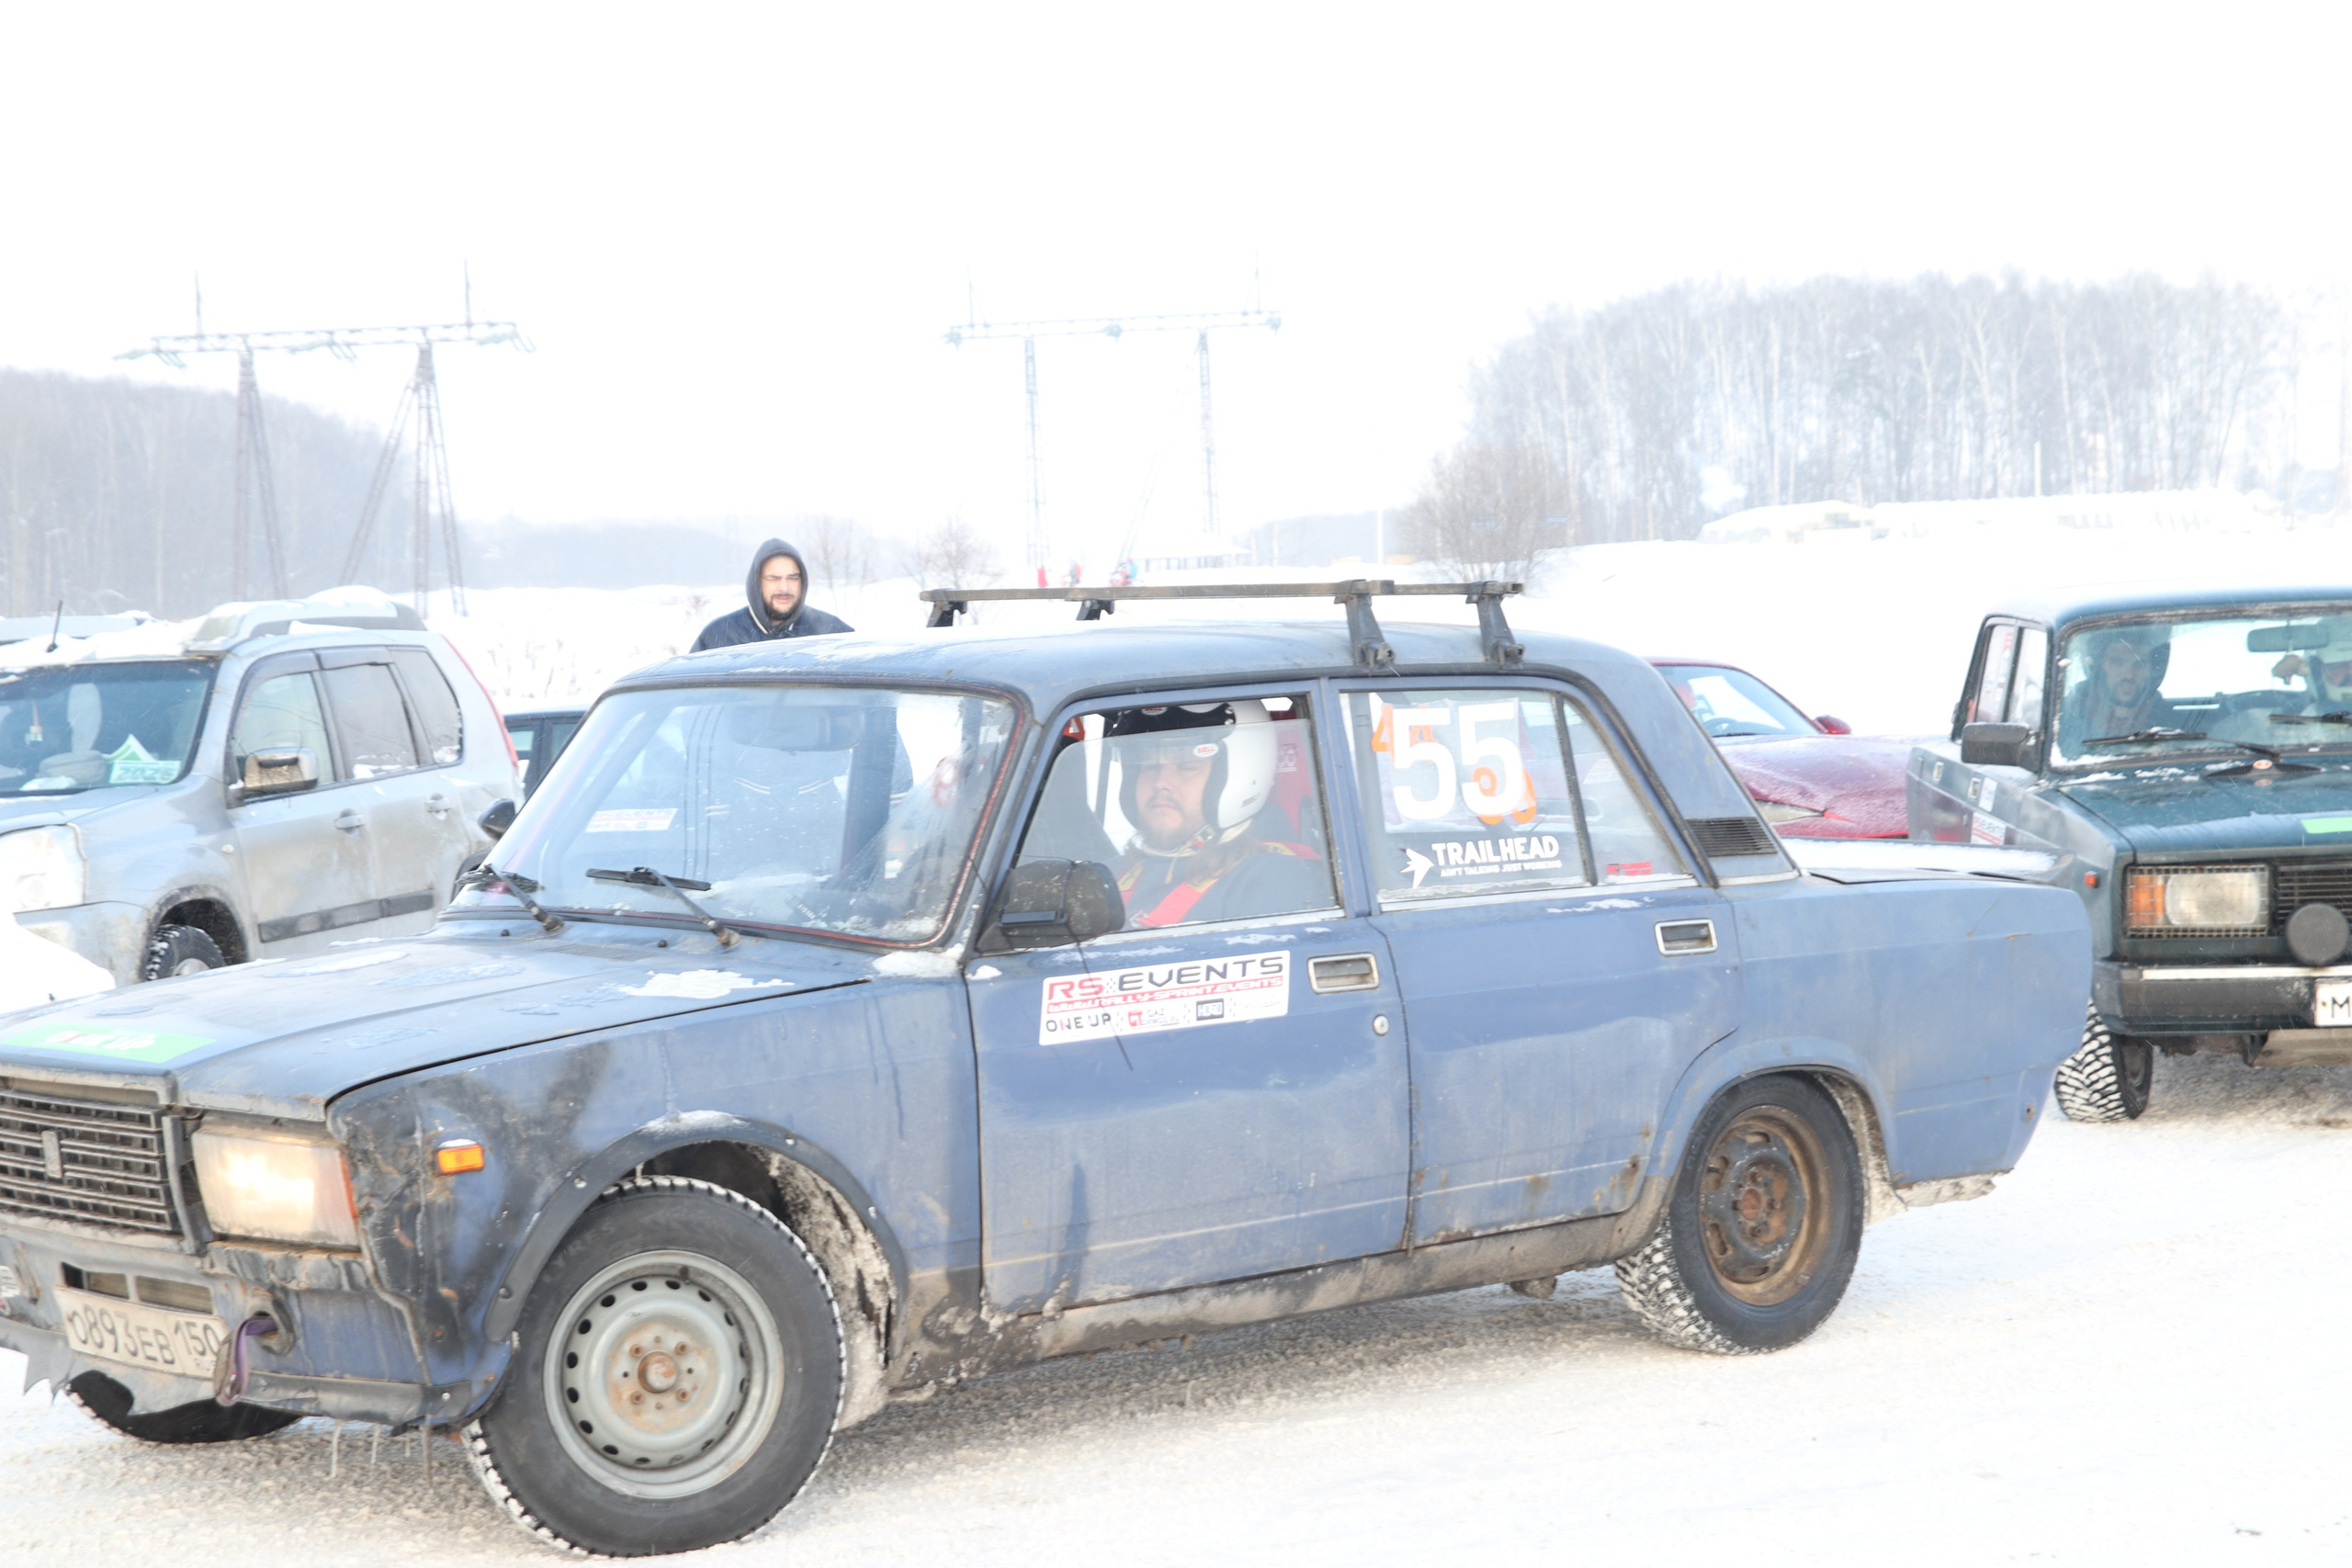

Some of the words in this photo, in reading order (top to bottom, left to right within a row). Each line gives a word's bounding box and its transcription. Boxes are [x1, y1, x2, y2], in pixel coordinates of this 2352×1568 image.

[1392, 702, 1525, 821] 55
[1430, 835, 1560, 866] TRAILHEAD
[1501, 862, 1522, 873] JUST
[1047, 976, 1104, 1000] RS
[1118, 956, 1283, 992] EVENTS
